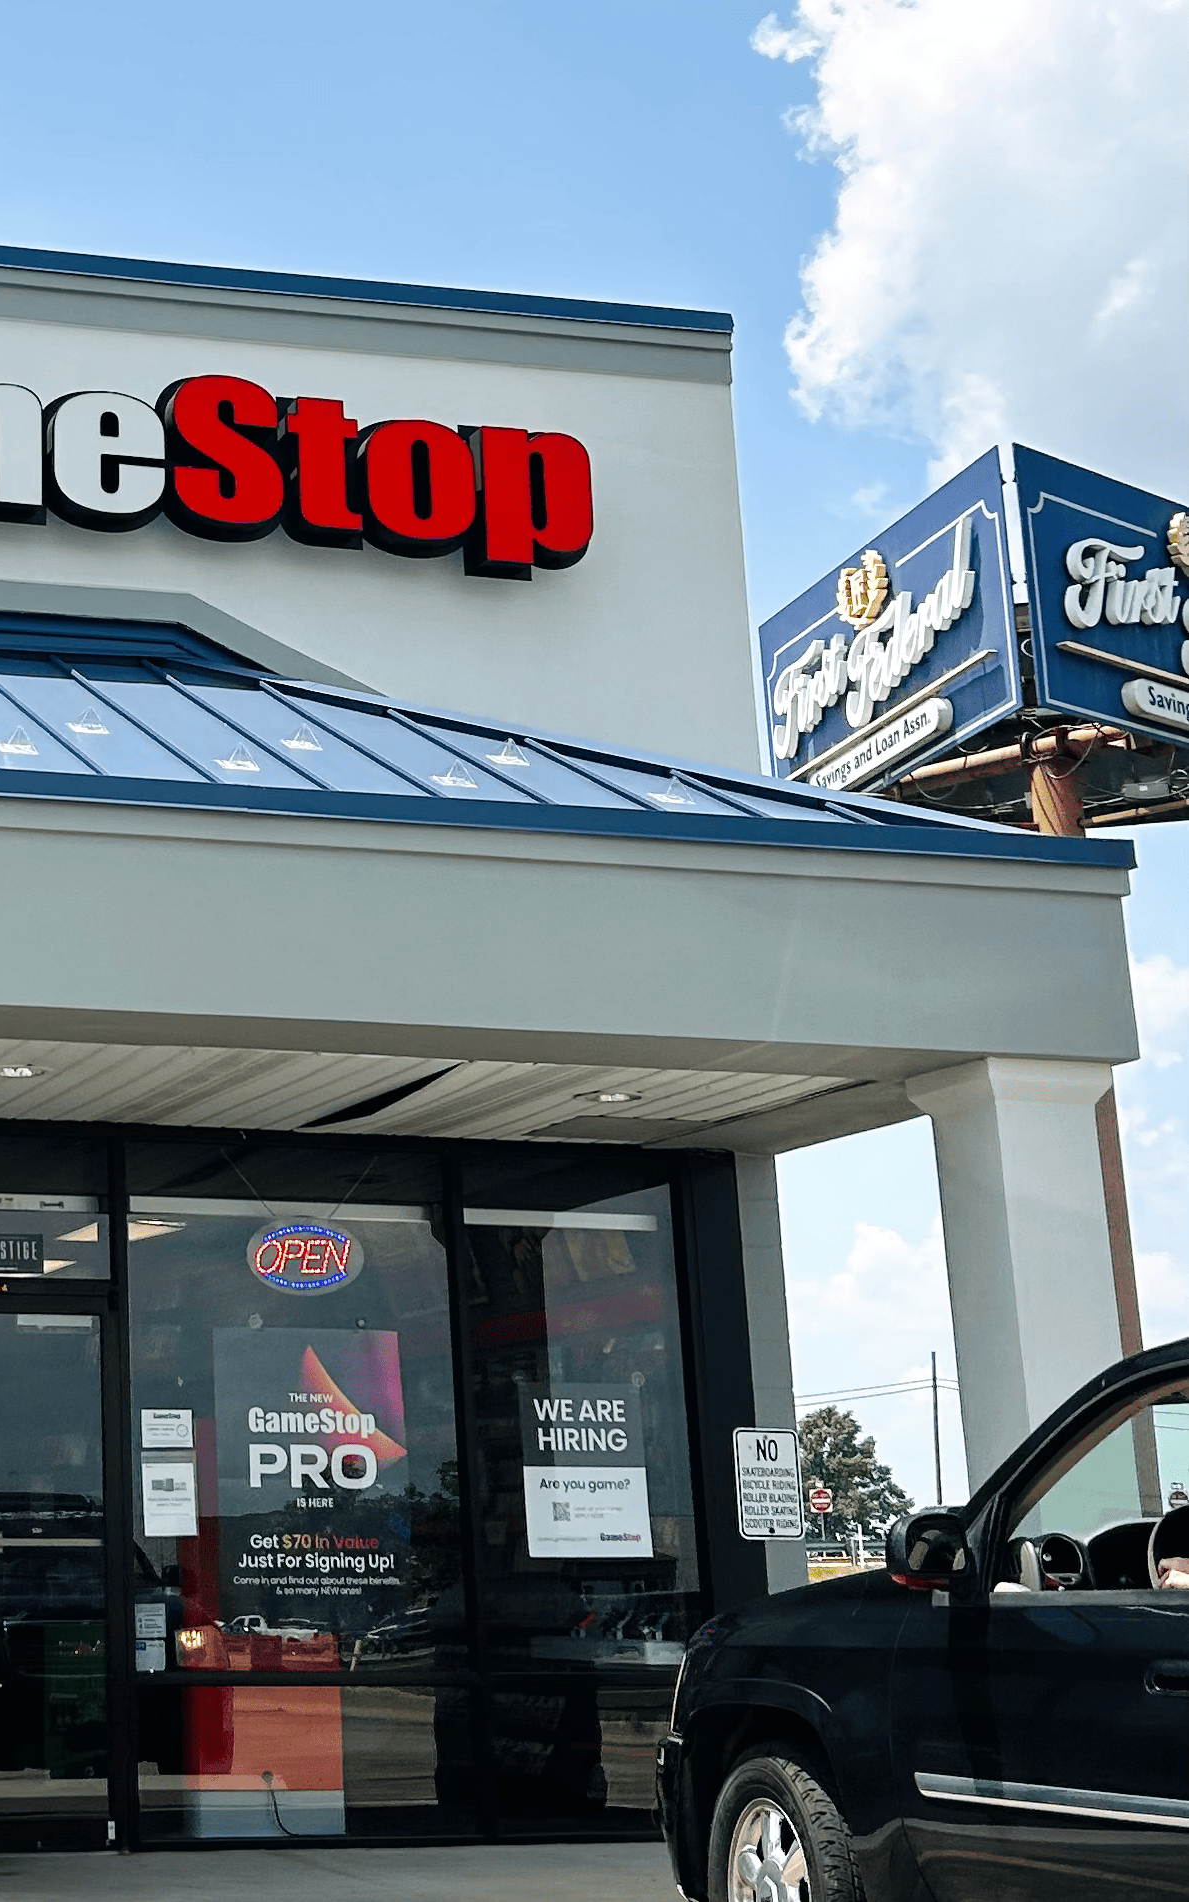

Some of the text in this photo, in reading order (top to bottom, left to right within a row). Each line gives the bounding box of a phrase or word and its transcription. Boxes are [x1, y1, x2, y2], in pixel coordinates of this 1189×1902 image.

[1064, 538, 1181, 630] First
[774, 516, 975, 759] First Federal
[854, 741, 873, 770] and
[875, 730, 900, 755] Loan
[903, 711, 932, 739] Assn.
[255, 1238, 351, 1275] OPEN
[289, 1393, 333, 1403] THE NEW
[248, 1406, 376, 1438] GameStop
[533, 1398, 626, 1423] WE ARE
[538, 1427, 628, 1452] HIRING
[756, 1438, 778, 1462] NO
[248, 1443, 378, 1489] PRO
[741, 1466, 796, 1478] SKATEBOARDING
[539, 1478, 631, 1493] Are you game?
[296, 1498, 334, 1508] IS HERE
[250, 1534, 279, 1549] Get
[282, 1534, 312, 1550] $70
[238, 1551, 394, 1573] Just For Signing Up!
[270, 1576, 288, 1585] and
[305, 1577, 319, 1585] out
[320, 1576, 345, 1585] about
